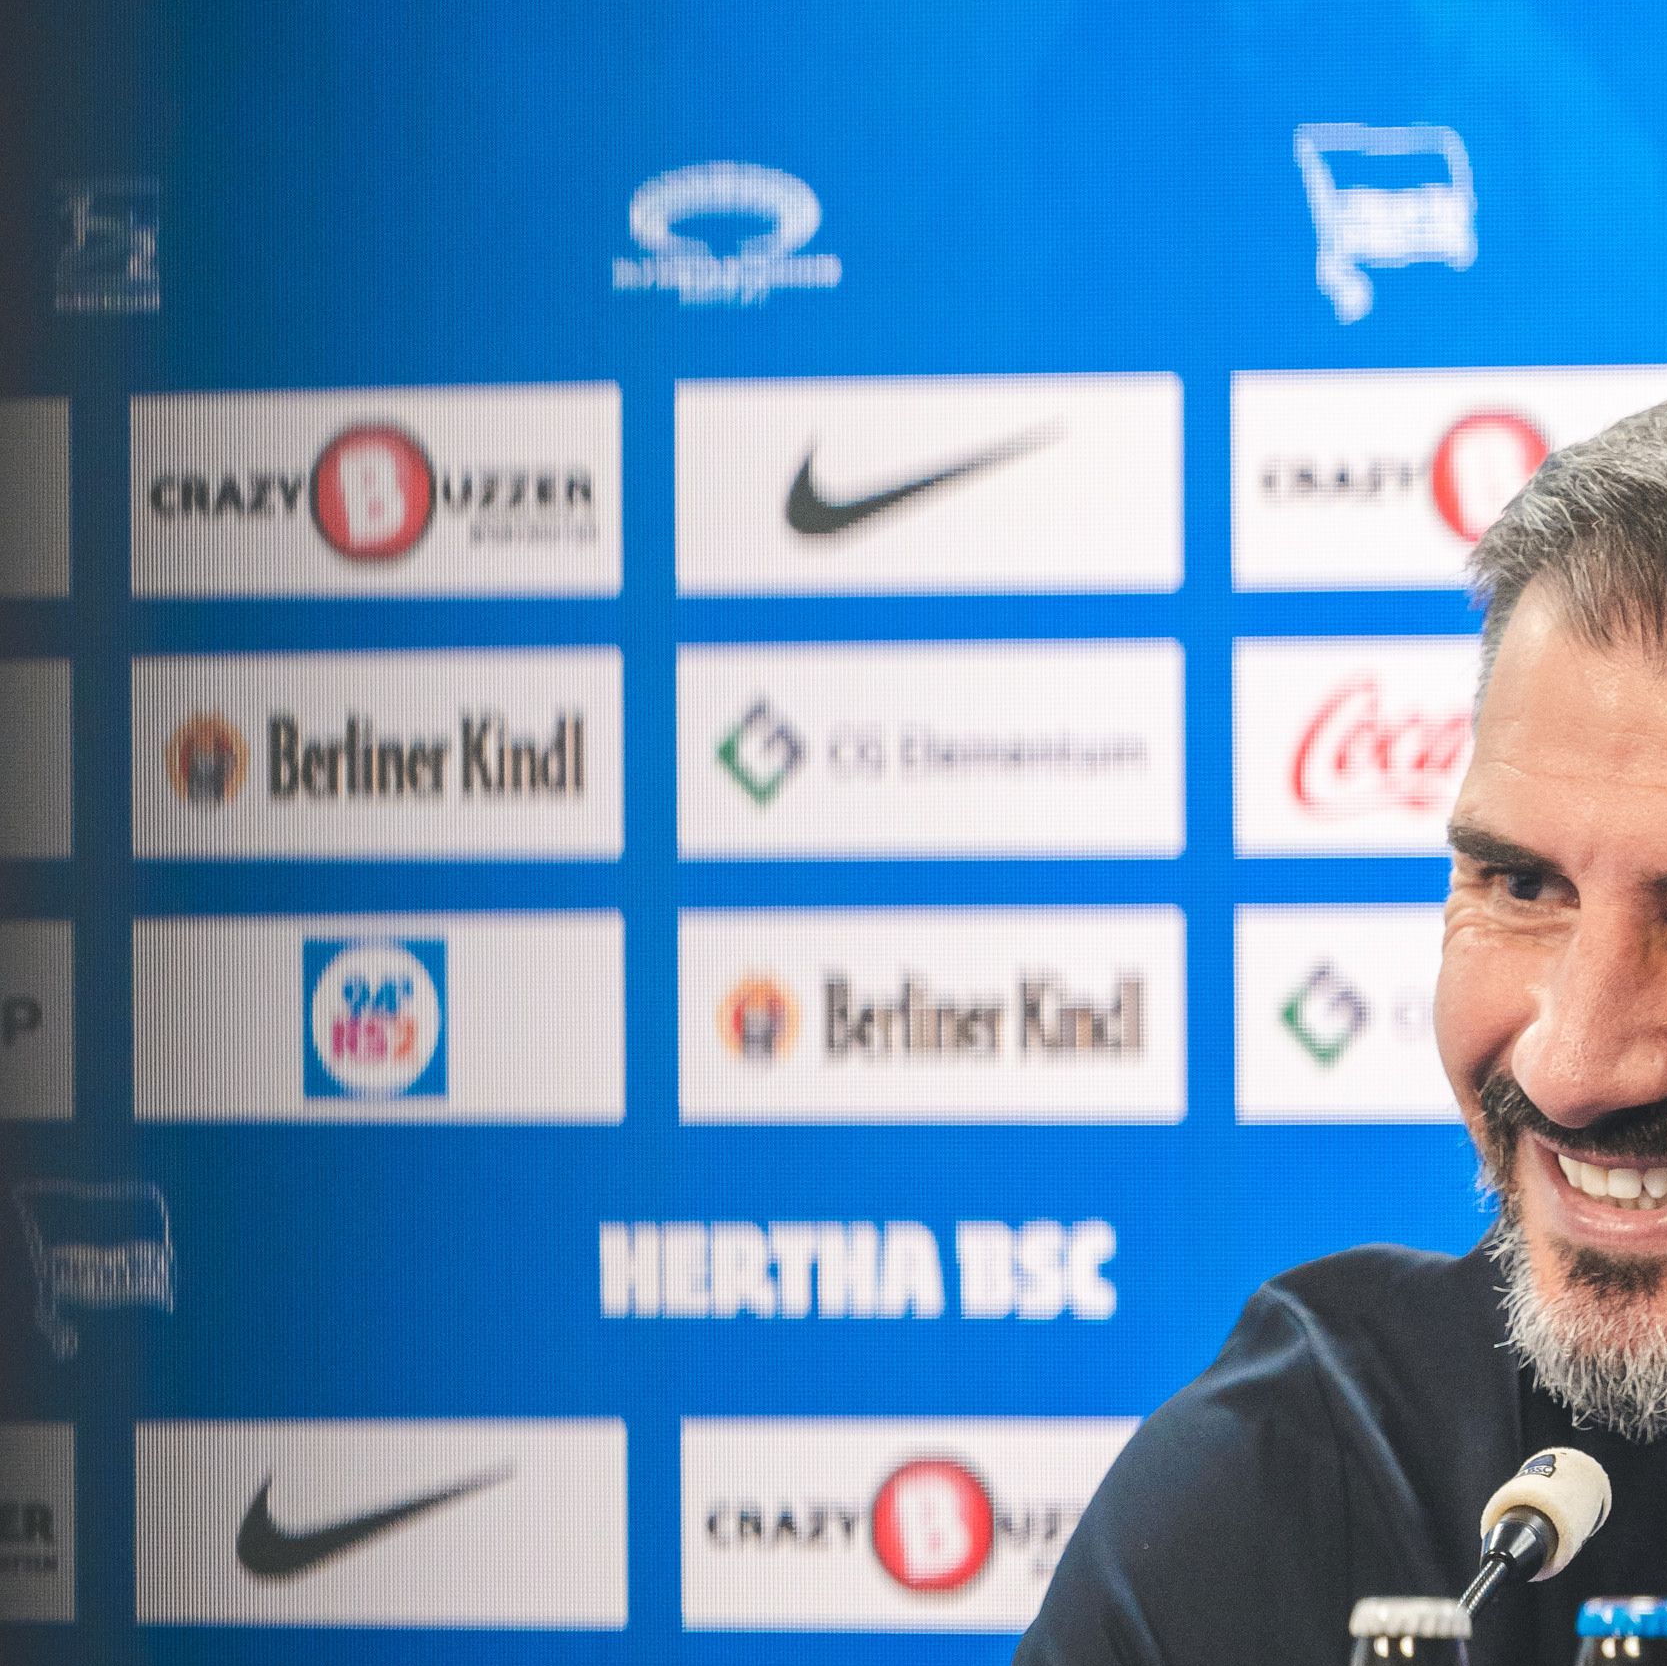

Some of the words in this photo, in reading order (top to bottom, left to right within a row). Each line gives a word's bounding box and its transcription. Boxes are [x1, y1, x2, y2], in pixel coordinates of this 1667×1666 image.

[266, 713, 450, 803] Berliner
[459, 713, 587, 803] Kindl
[822, 971, 1006, 1061] Berliner
[1016, 971, 1146, 1061] Kindl
[598, 1218, 947, 1321] HERTHA
[955, 1217, 1119, 1321] BSC
